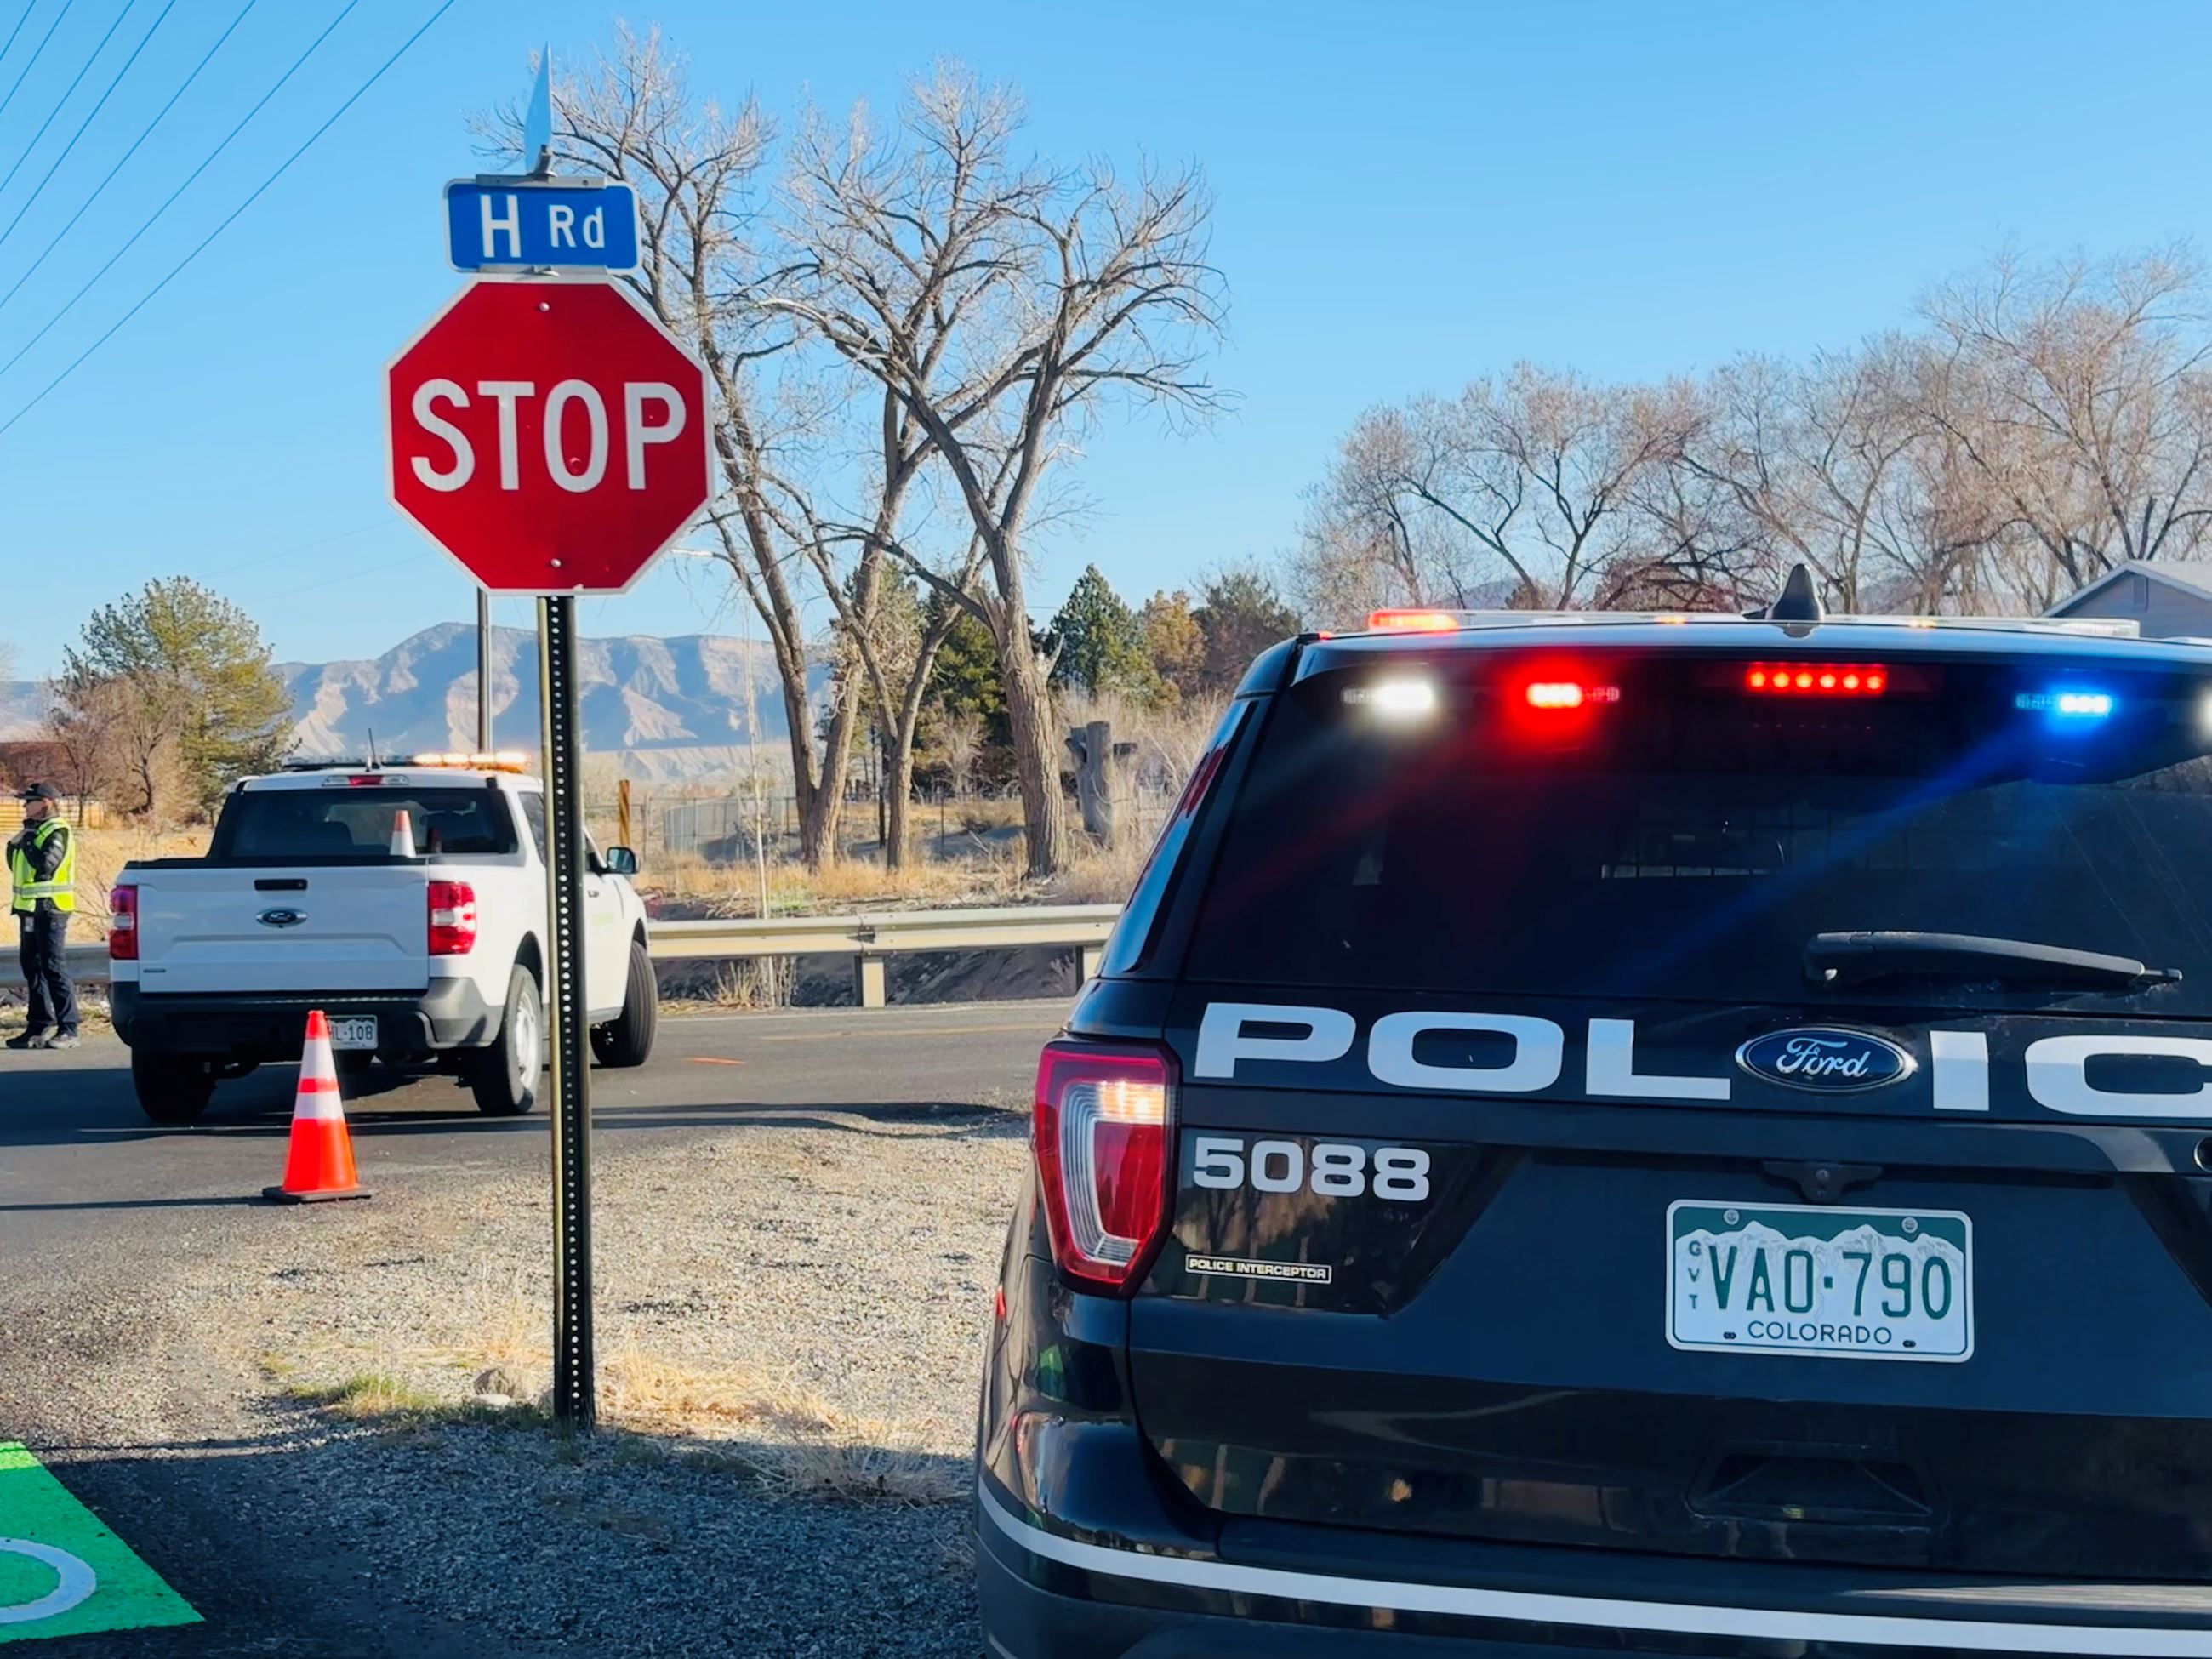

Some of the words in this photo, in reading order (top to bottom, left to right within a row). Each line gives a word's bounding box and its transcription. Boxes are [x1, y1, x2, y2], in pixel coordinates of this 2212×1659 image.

[480, 194, 522, 258] H
[549, 204, 605, 248] Rd
[410, 378, 687, 493] STOP
[1776, 1037, 1871, 1078] Ford
[1193, 1137, 1431, 1201] 5088
[1189, 1258, 1234, 1273] POLICE
[1236, 1263, 1326, 1279] INTERCEPTOR
[1747, 1320, 1893, 1344] COLORADO
